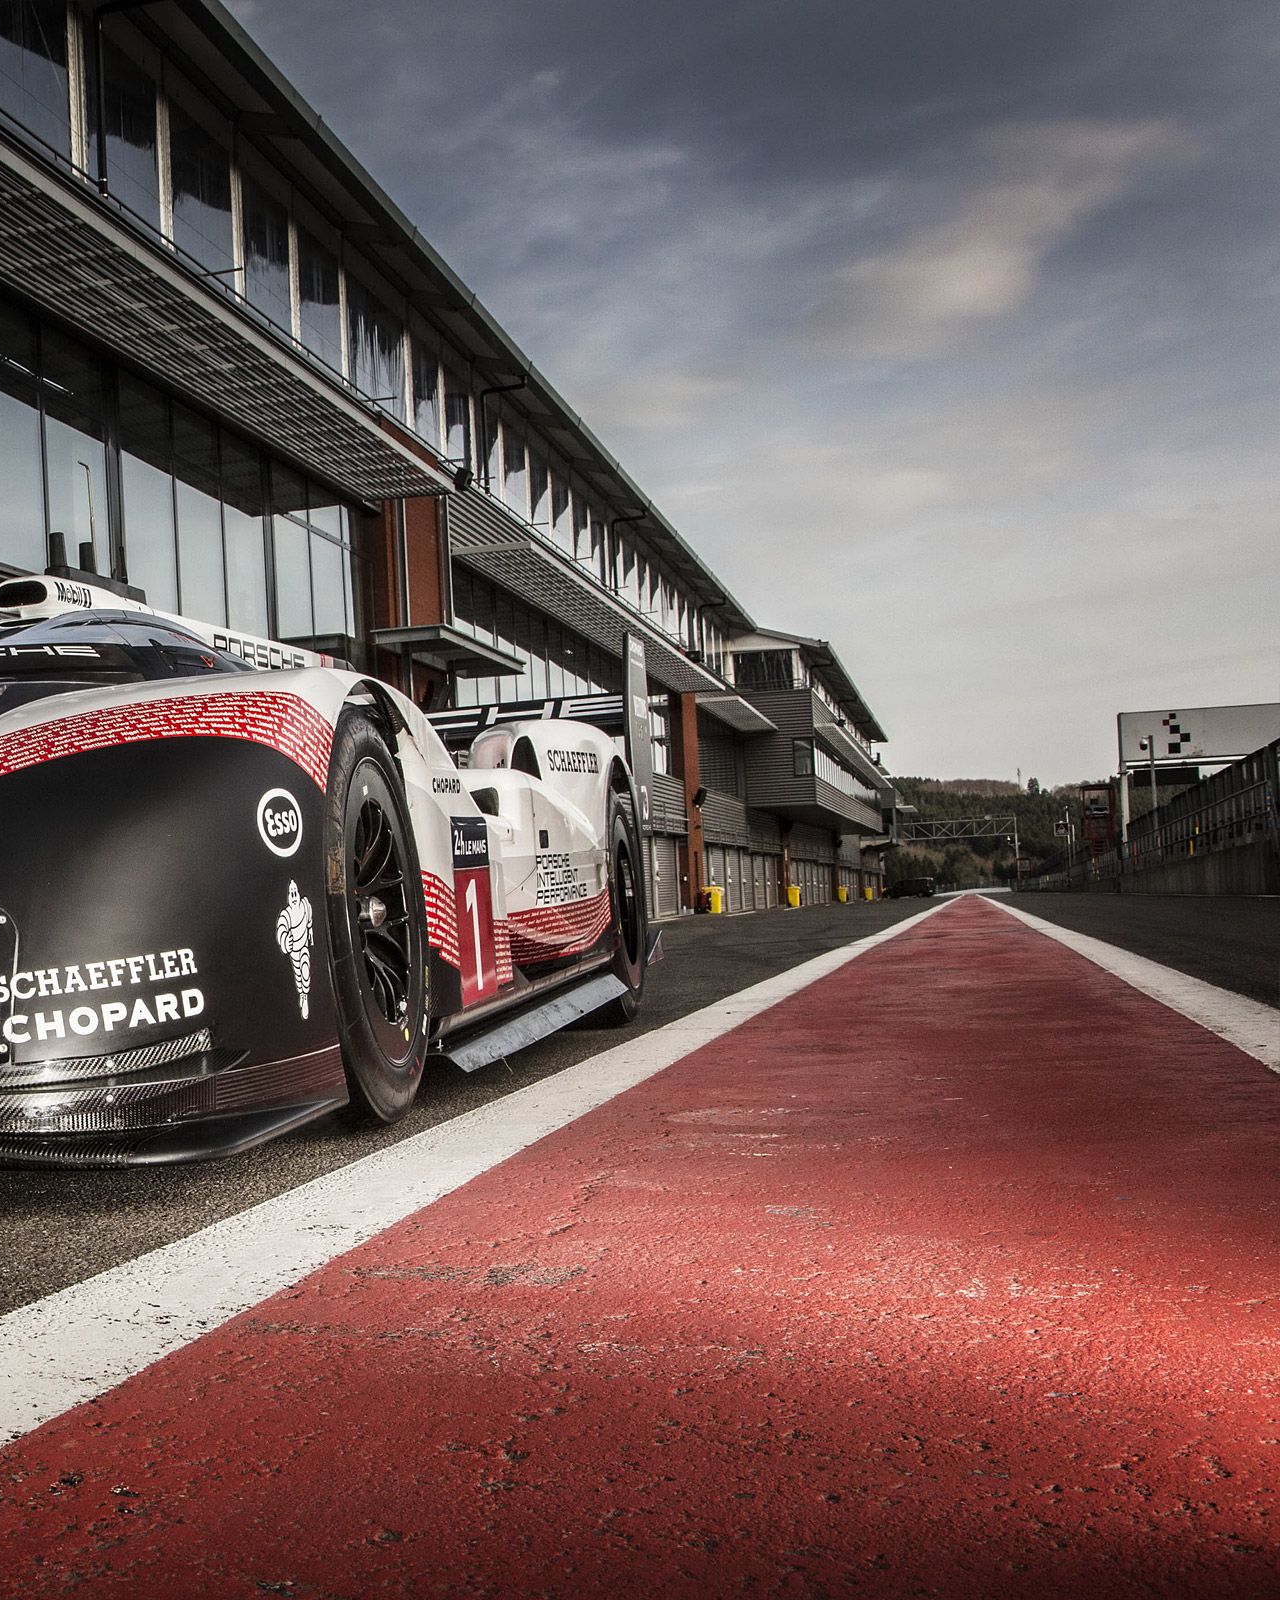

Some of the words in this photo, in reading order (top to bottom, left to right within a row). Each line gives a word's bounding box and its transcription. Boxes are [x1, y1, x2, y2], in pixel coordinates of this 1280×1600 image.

[54, 581, 82, 606] Mobil
[213, 634, 305, 670] PORSCHE
[547, 749, 599, 774] SCHAEFFLER
[432, 777, 460, 794] CHOPARD
[264, 807, 298, 838] Esso
[465, 840, 472, 856] LE
[472, 839, 486, 855] MANS
[536, 853, 570, 869] PORSCHE
[536, 868, 578, 889] INTELLIGENT
[535, 883, 588, 906] PERFORMANCE
[466, 878, 484, 991] 1
[2, 988, 205, 1045] CHOPARD
